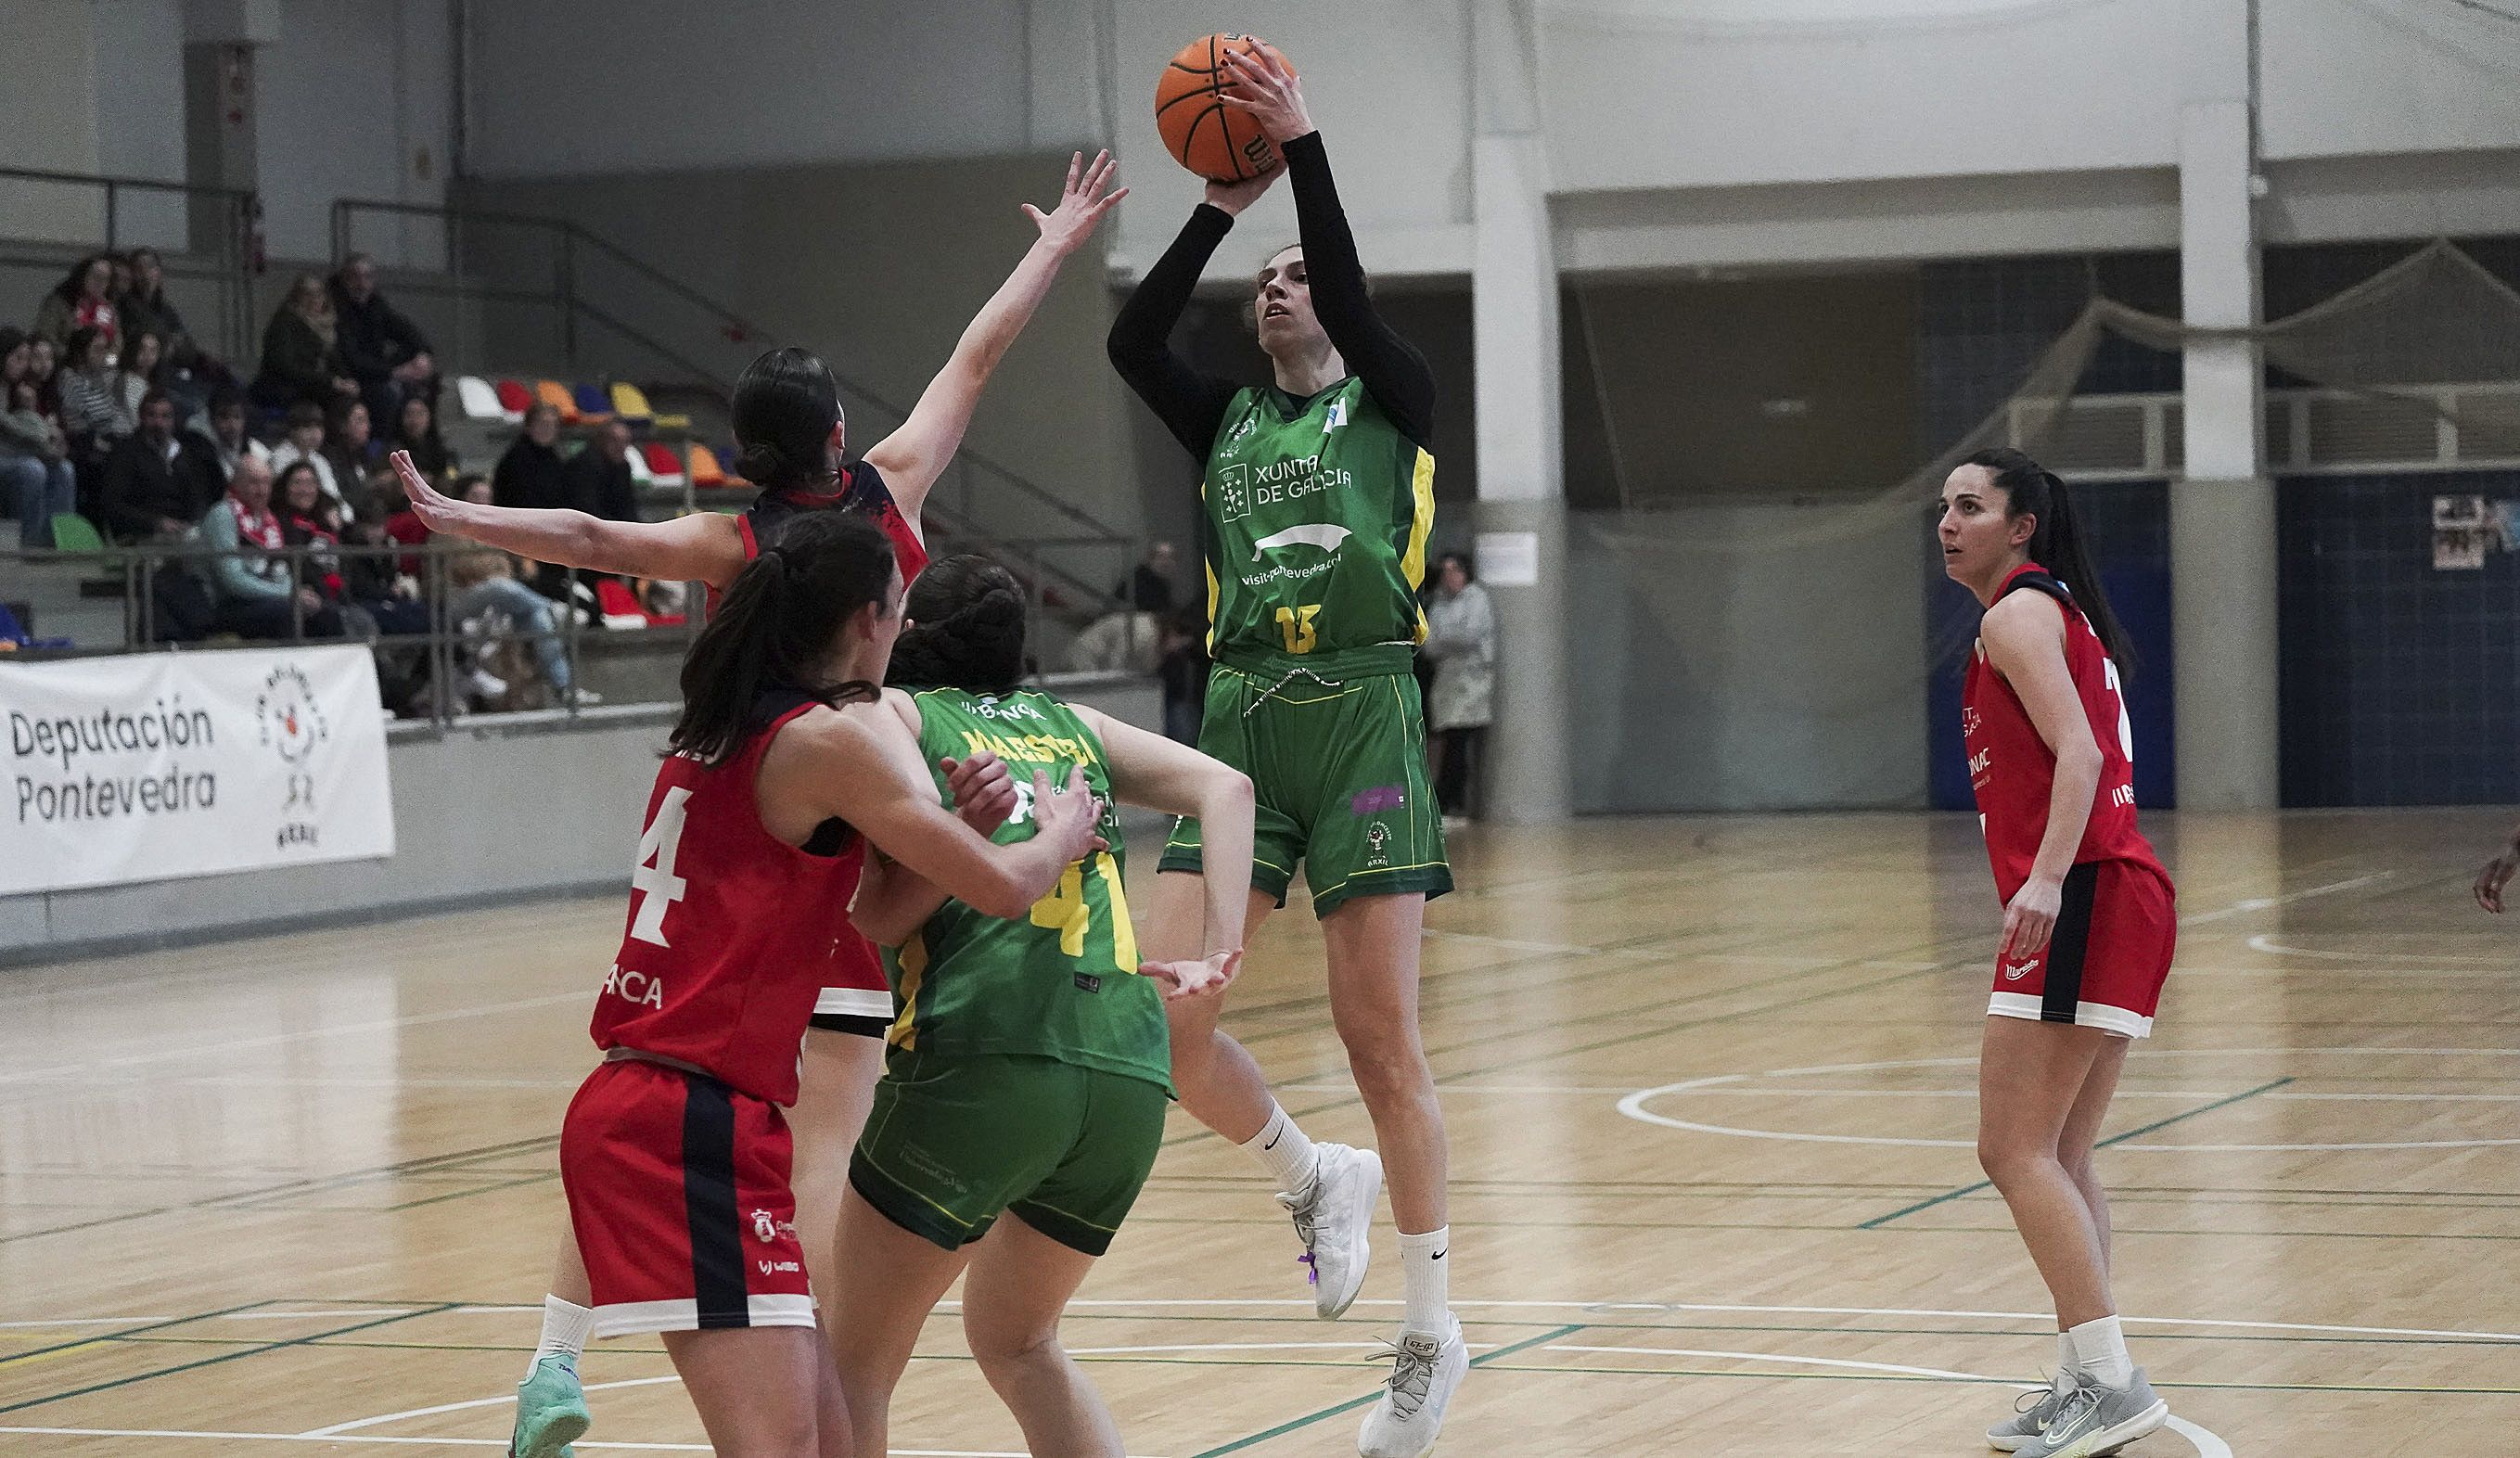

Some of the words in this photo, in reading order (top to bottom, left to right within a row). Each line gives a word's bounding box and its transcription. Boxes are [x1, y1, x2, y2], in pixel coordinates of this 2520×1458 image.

[1255, 455, 1319, 484] XUNTA
[1257, 485, 1284, 505] DE
[1288, 468, 1352, 498] GALICIA
[16, 764, 217, 825] Pontevedra
[630, 786, 694, 949] 4
